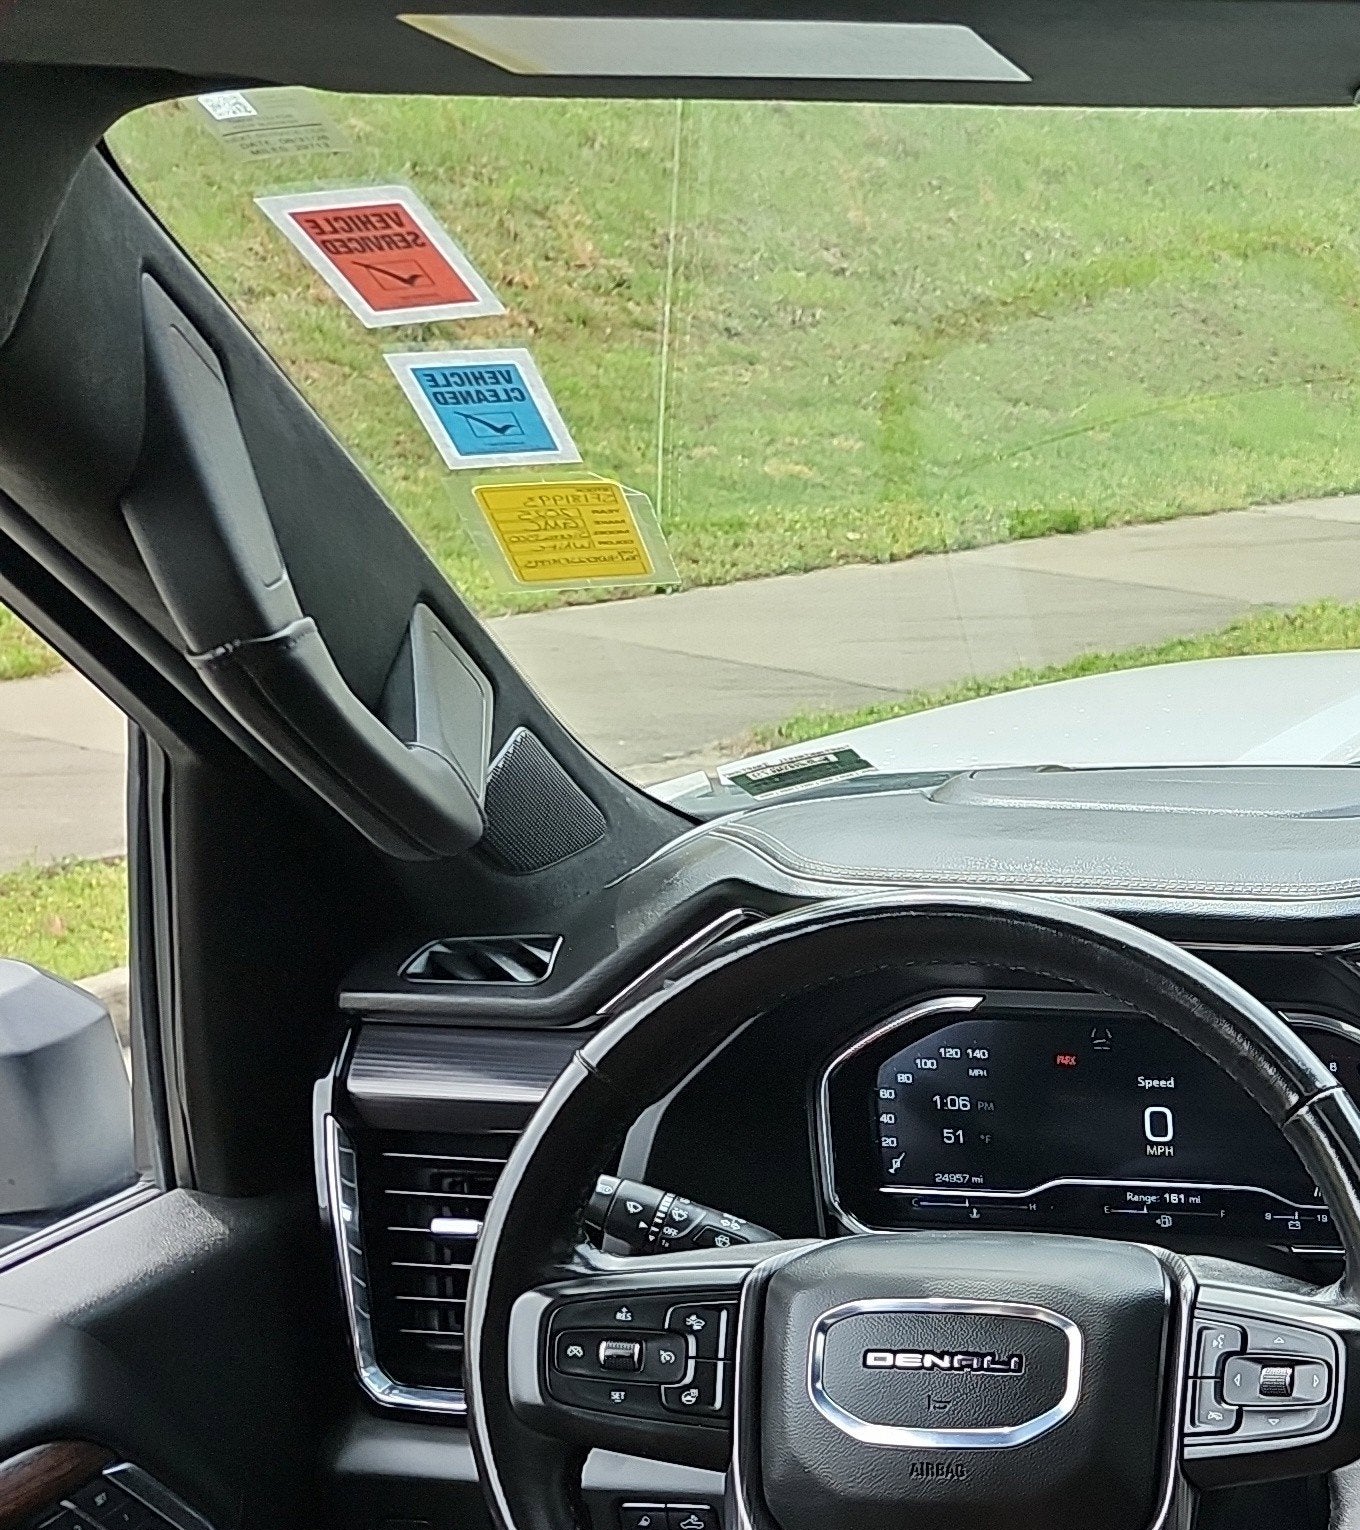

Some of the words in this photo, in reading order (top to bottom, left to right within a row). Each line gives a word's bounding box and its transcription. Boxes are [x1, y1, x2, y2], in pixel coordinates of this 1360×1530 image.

[939, 1047, 961, 1059] 120
[966, 1048, 989, 1060] 140
[915, 1058, 937, 1070] 100
[897, 1073, 913, 1084] 80
[1137, 1075, 1175, 1089] Speed
[879, 1089, 896, 1100] 60
[932, 1094, 971, 1111] 1:06
[977, 1101, 995, 1111] PM
[879, 1113, 896, 1124] 40
[1144, 1106, 1174, 1142] 0
[881, 1137, 898, 1148] 20
[943, 1128, 964, 1144] 51
[1146, 1144, 1175, 1157] MPH
[934, 1173, 970, 1183] 24957
[971, 1174, 984, 1183] mi
[1126, 1191, 1161, 1204] Range:
[1188, 1195, 1201, 1204] mi
[1104, 1205, 1111, 1214] E
[1220, 1210, 1226, 1219] F
[1316, 1214, 1328, 1223] 19
[866, 1351, 1020, 1370] DENALI
[610, 1391, 626, 1400] SET
[909, 1461, 967, 1478] AIRBAG
